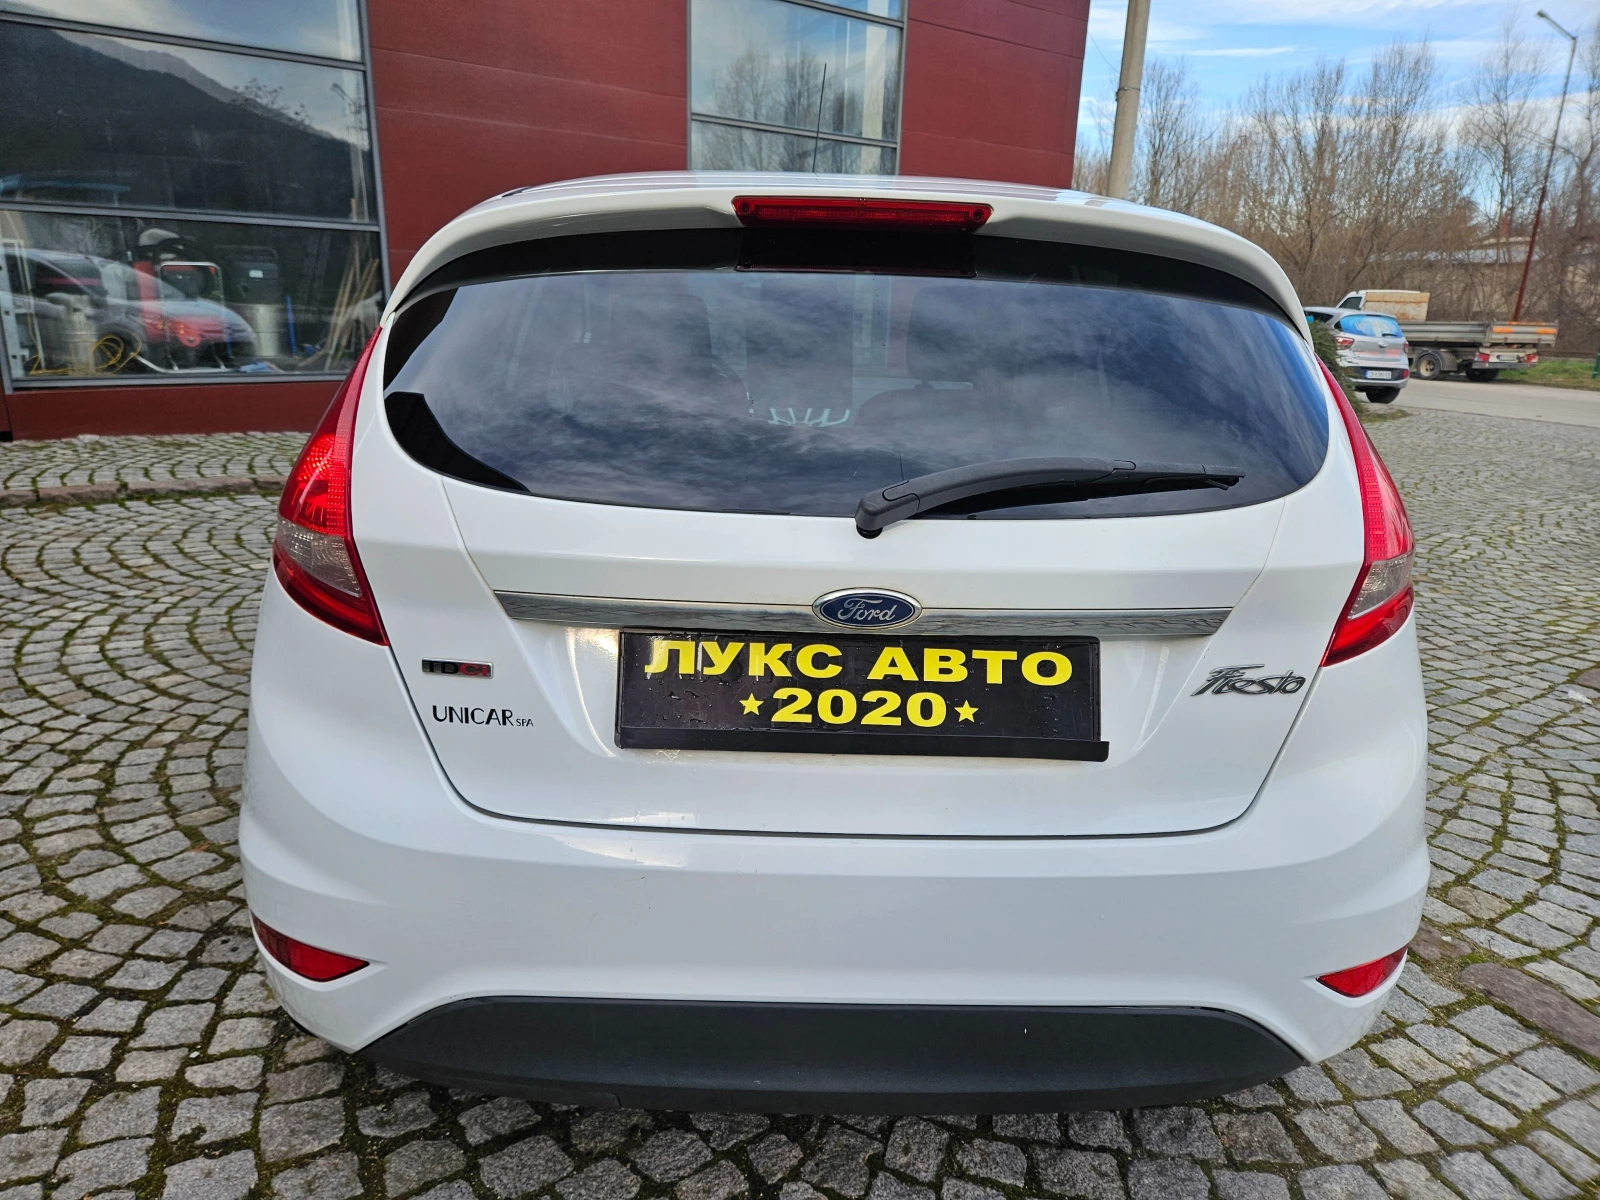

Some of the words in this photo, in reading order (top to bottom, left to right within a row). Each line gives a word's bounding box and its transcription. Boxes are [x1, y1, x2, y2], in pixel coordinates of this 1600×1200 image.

[837, 597, 897, 621] Ford
[644, 640, 843, 679] ЛУКС
[866, 646, 1073, 686] АВТО
[432, 704, 514, 727] UNICAR
[515, 718, 534, 727] SPA
[771, 687, 947, 728] 2020
